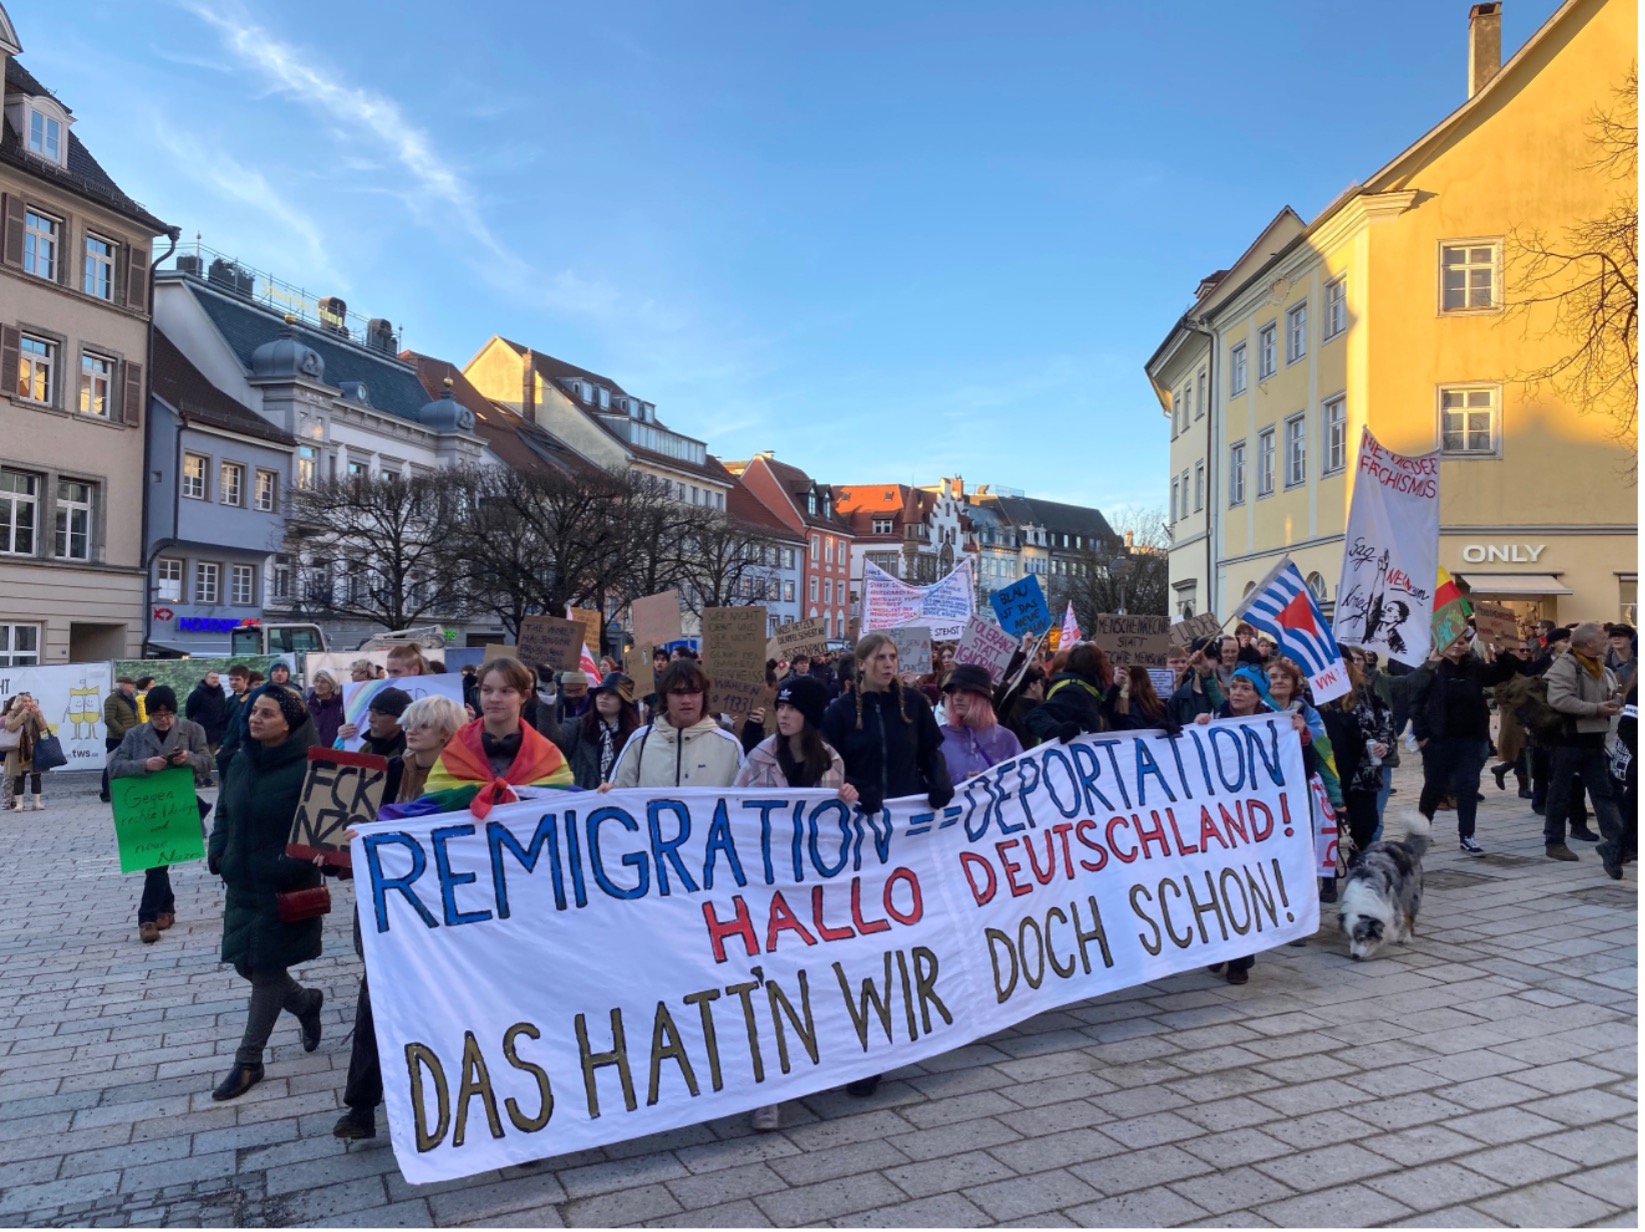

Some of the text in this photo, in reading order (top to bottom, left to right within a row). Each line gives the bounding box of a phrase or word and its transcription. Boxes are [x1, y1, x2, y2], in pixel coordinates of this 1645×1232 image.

[1463, 544, 1546, 562] ONLY
[1386, 568, 1412, 591] NEIN
[998, 583, 1028, 605] BLAU
[730, 610, 760, 620] NICHT
[1017, 599, 1038, 614] DAS
[934, 626, 960, 637] STEHST
[970, 615, 1016, 653] TOLERANZ
[1117, 636, 1148, 647] STATT
[971, 637, 1002, 661] STATT
[124, 785, 174, 809] Gegen
[303, 759, 384, 820] FCK
[363, 798, 893, 933] REMIGRATION
[963, 719, 1287, 843] DEPORTATION
[702, 866, 923, 963] HALLO
[959, 793, 1294, 907] DEUTSCHLAND!
[404, 858, 1295, 1152] DAS HATT'N WIR DOCH SCHON!
